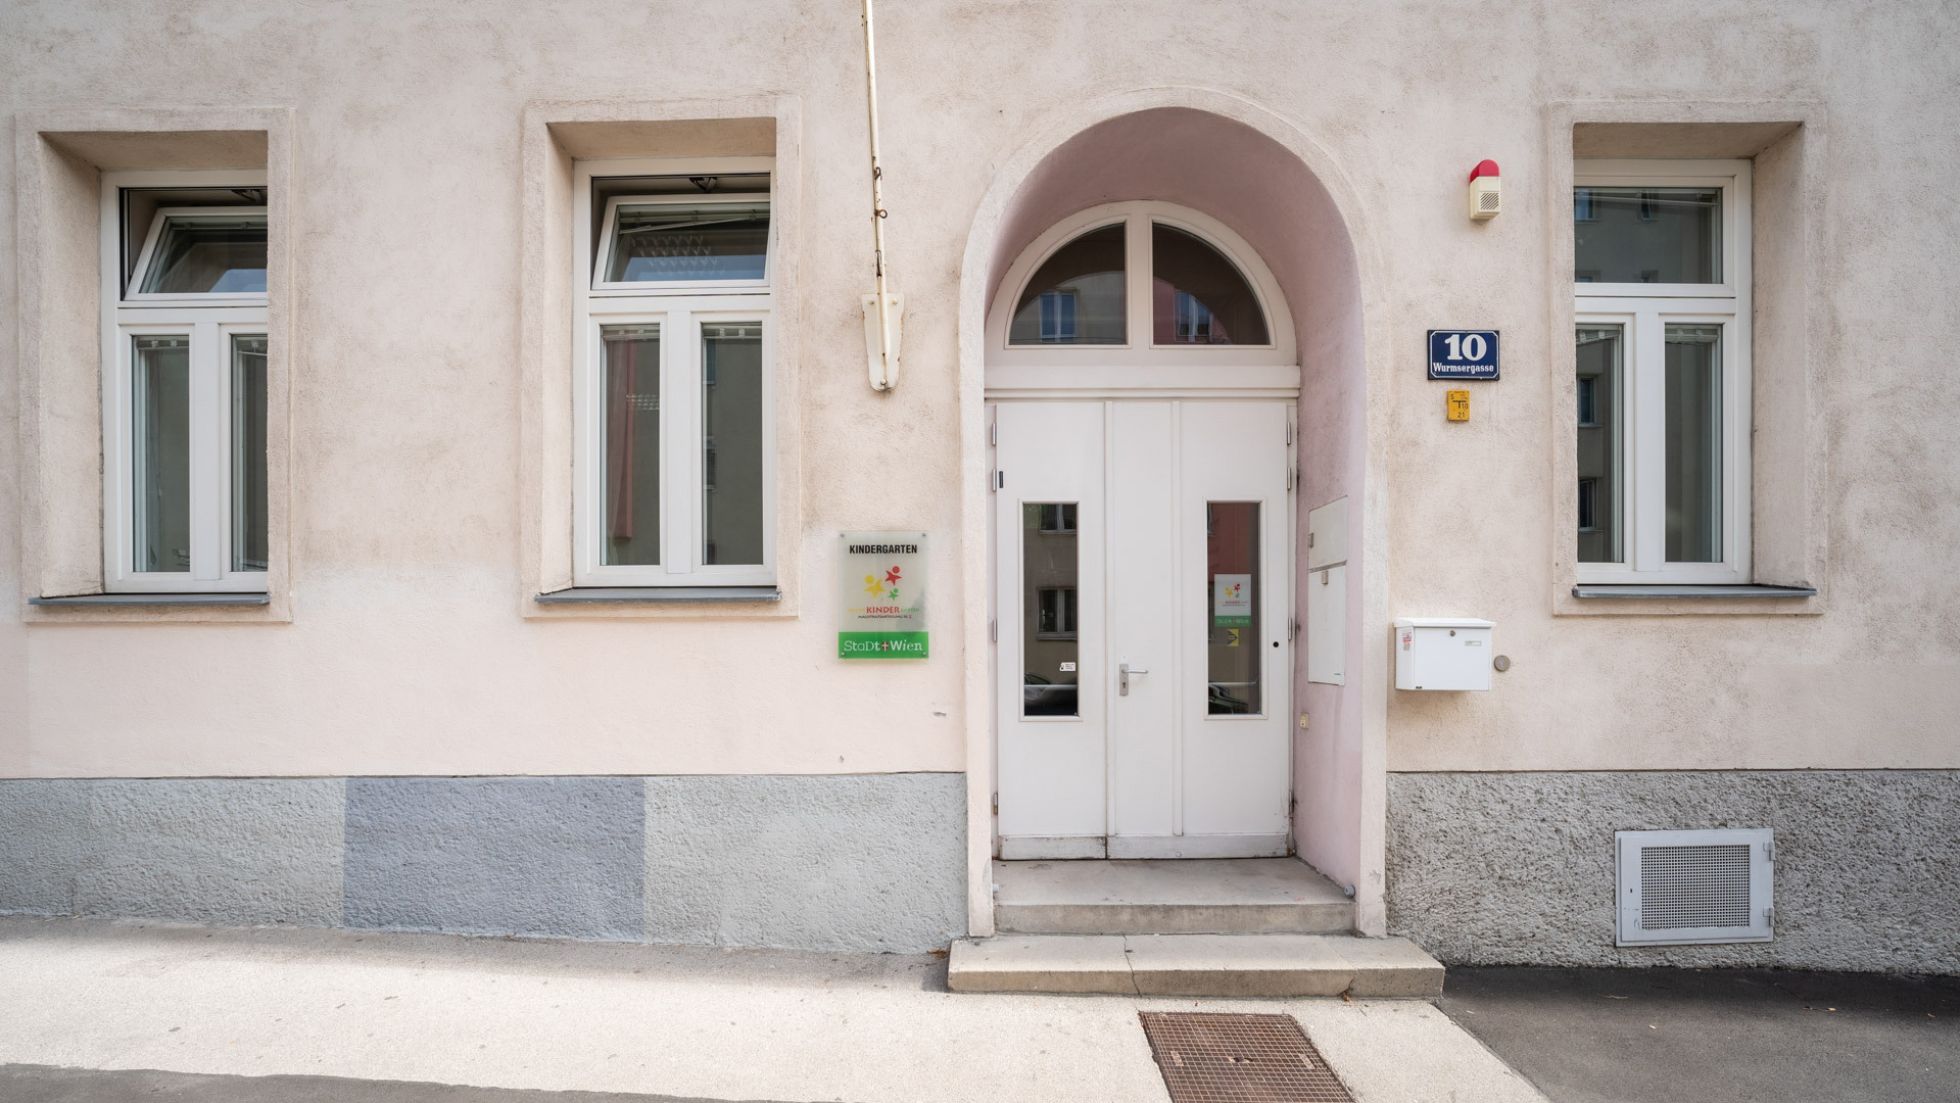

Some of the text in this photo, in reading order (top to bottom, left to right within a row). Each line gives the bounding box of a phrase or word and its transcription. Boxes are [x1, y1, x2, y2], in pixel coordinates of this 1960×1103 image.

[1444, 333, 1487, 361] 10
[1433, 362, 1494, 374] Wurmsergasse
[849, 544, 918, 554] KINDERGARTEN
[866, 606, 900, 614] KINDER
